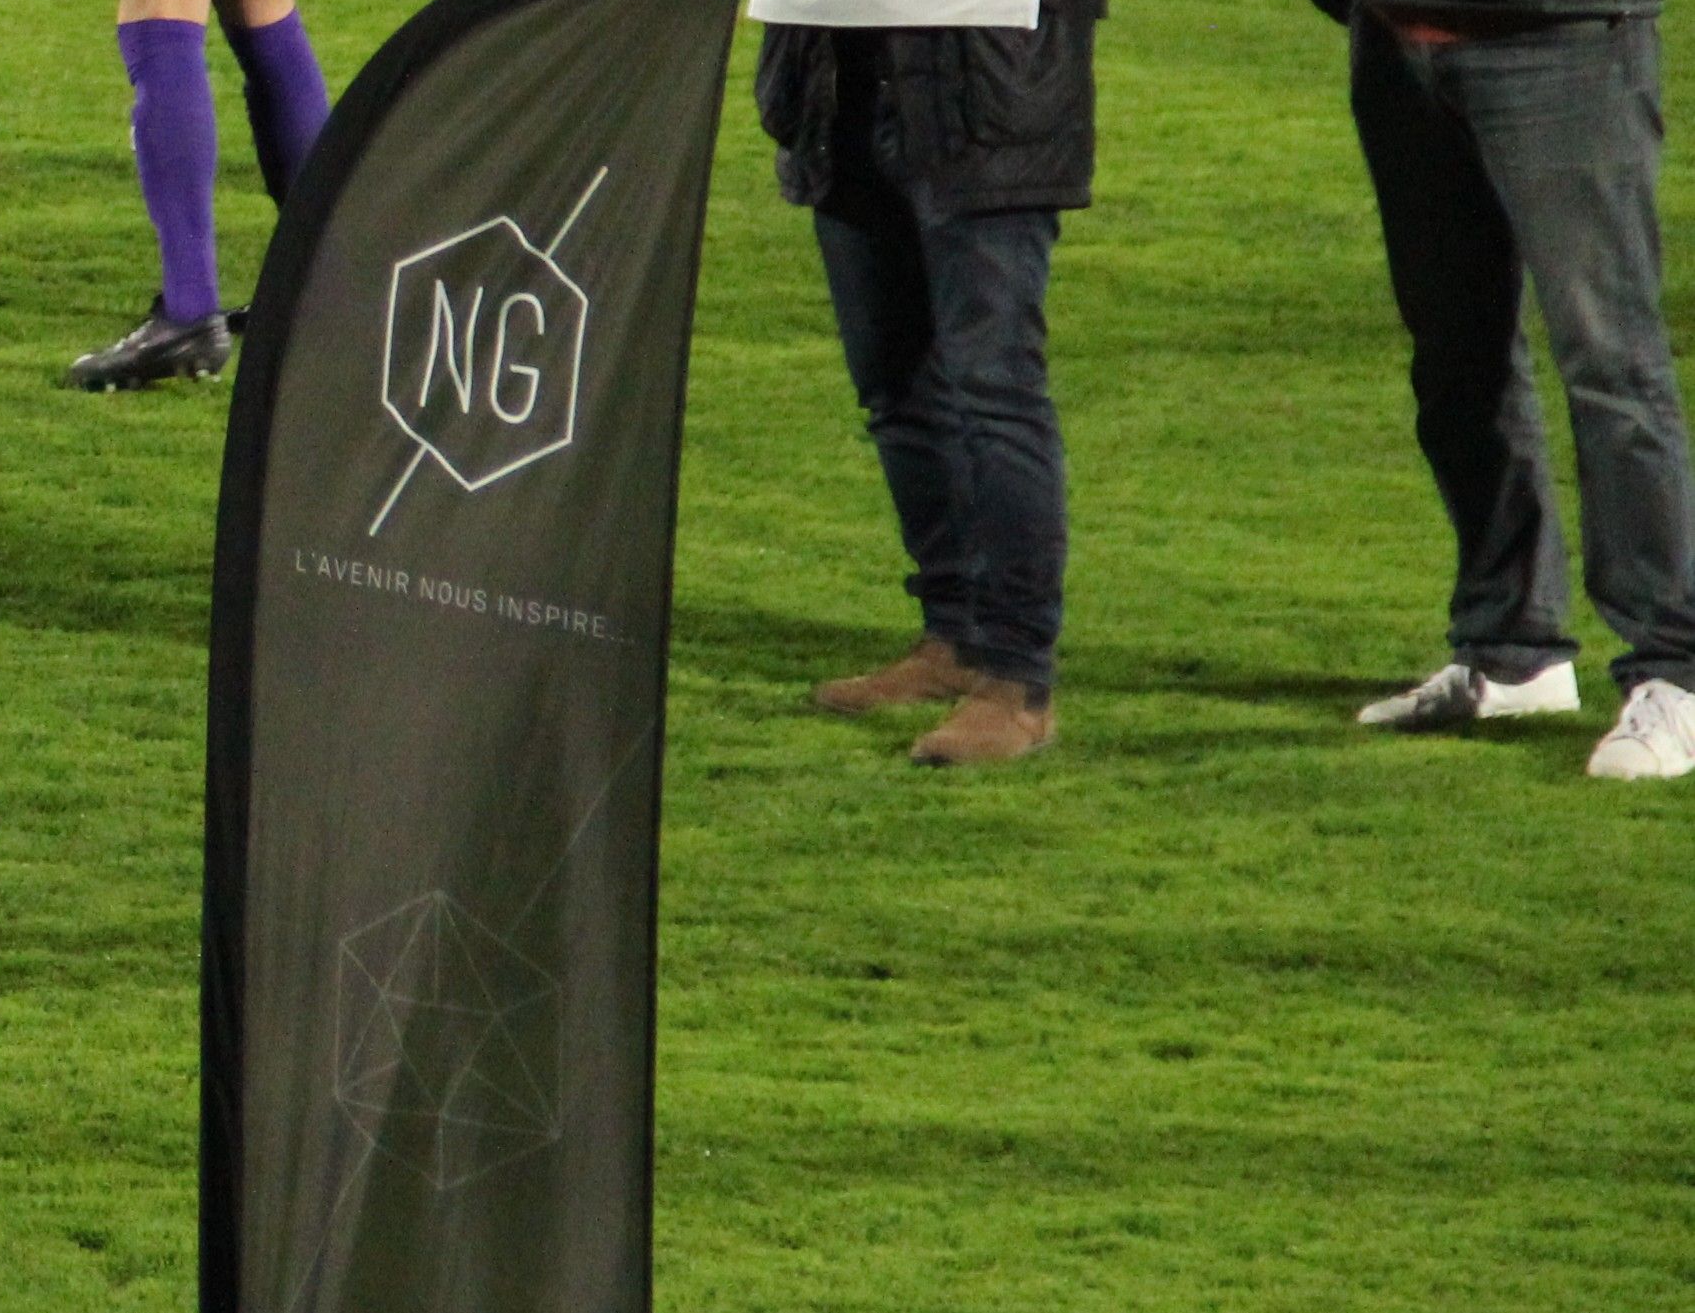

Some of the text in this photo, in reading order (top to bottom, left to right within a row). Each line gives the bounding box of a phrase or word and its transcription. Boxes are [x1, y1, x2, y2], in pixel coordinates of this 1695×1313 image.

[419, 278, 546, 424] NG
[294, 549, 410, 594] L'AVENIR
[418, 576, 488, 614] NOUS
